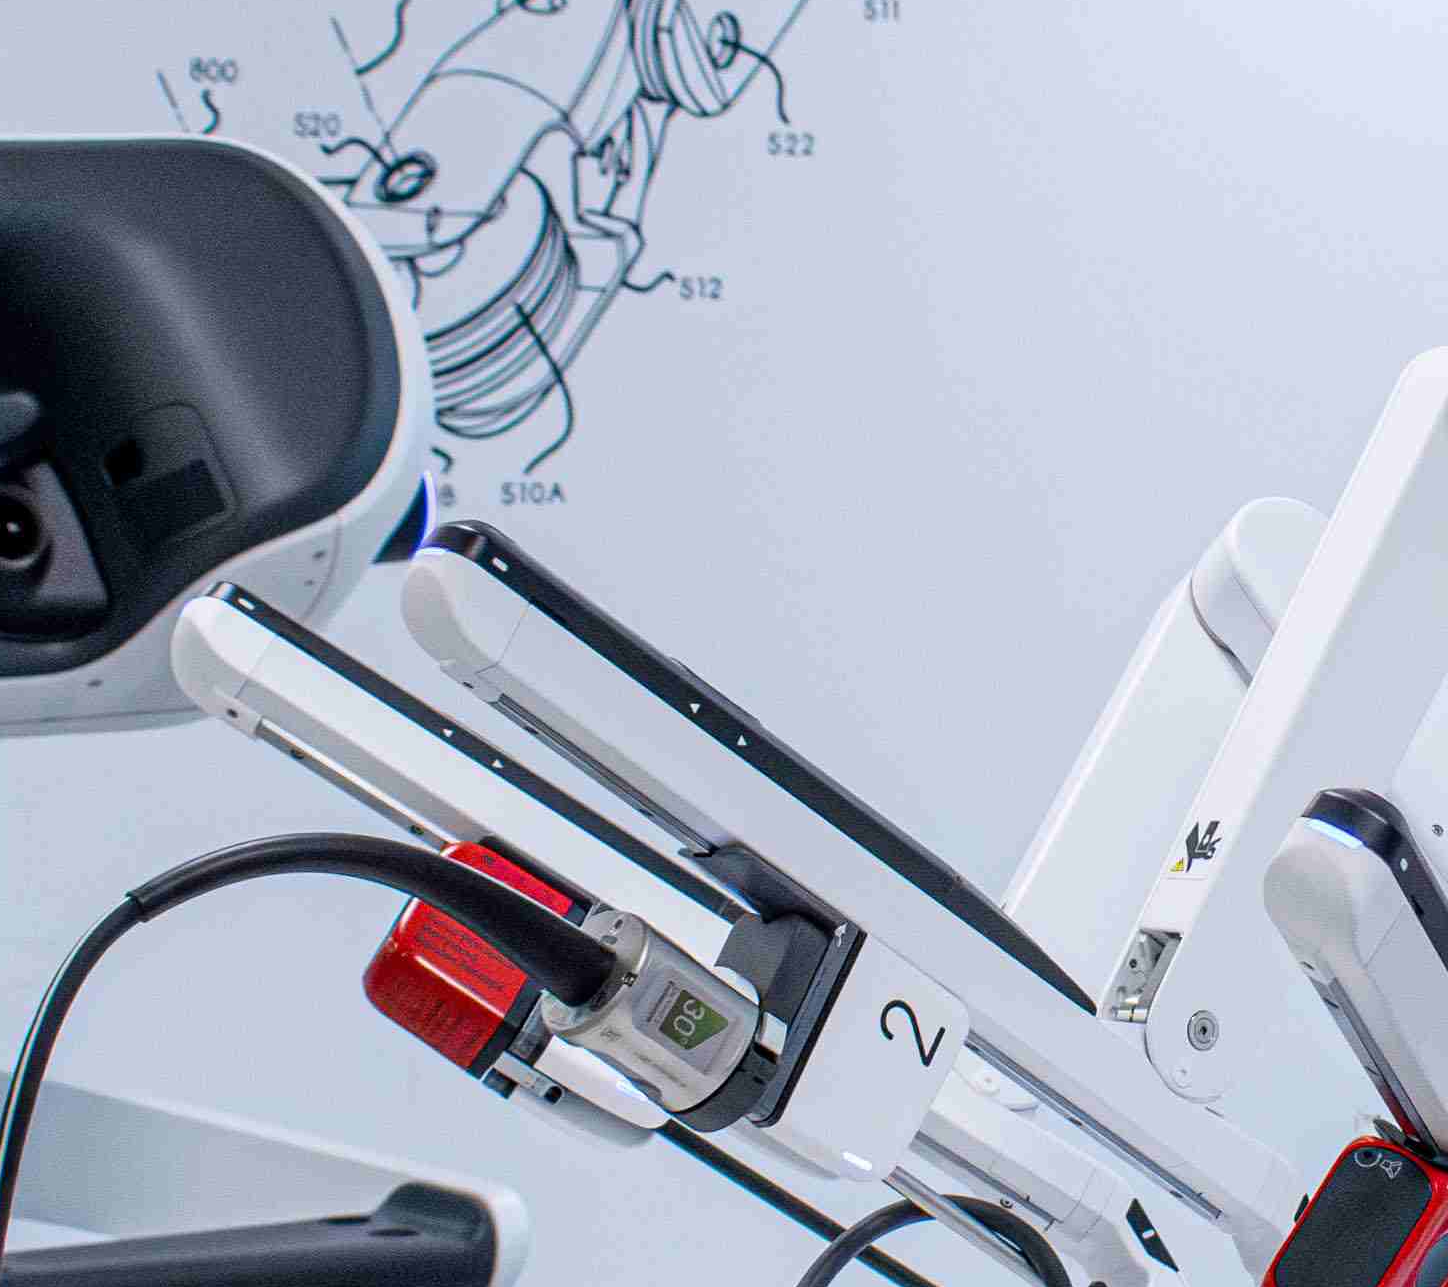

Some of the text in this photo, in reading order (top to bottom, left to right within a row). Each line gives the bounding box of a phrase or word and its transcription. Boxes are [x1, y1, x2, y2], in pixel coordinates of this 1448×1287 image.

[189, 57, 239, 84] 800
[293, 112, 342, 137] 520
[768, 132, 816, 156] 522
[679, 276, 724, 301] 512
[500, 480, 568, 506] 510A
[879, 999, 947, 1068] 2
